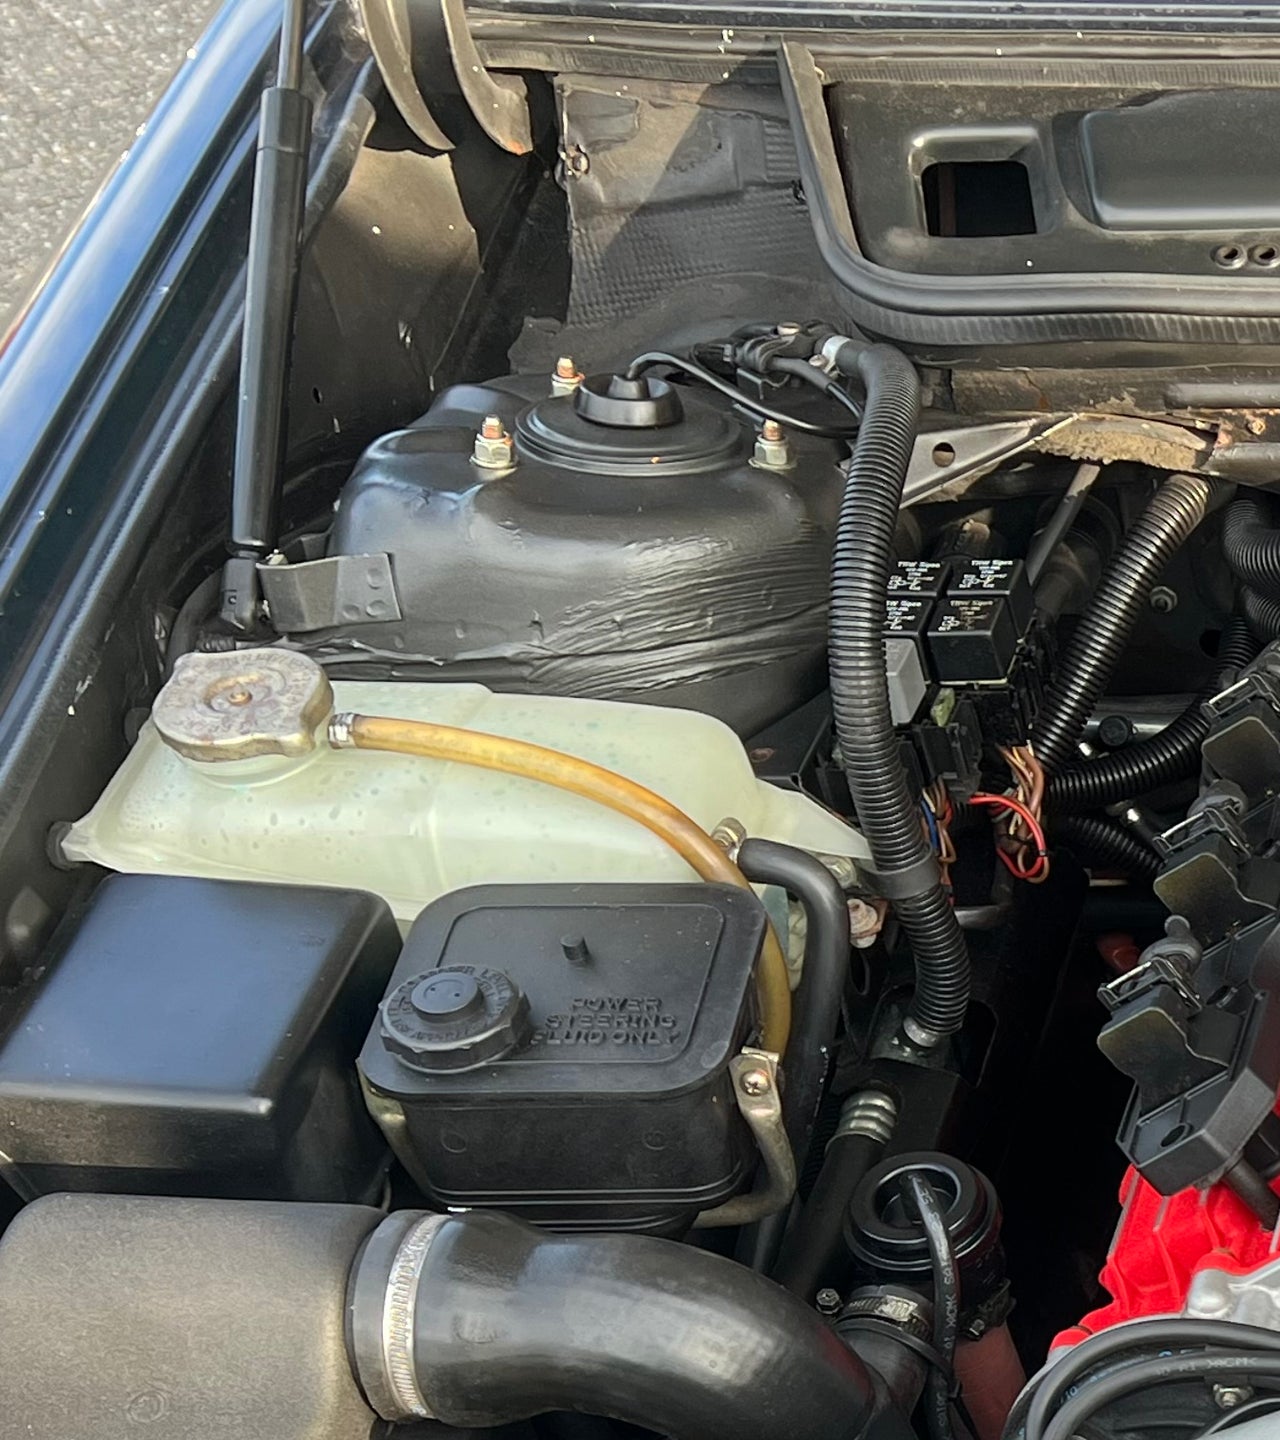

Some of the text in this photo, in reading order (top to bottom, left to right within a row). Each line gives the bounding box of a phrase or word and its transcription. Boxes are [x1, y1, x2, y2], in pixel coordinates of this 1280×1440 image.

[571, 997, 662, 1012] POWER
[544, 1013, 677, 1028] STEERING
[528, 1030, 681, 1046] FLUID ONLY
